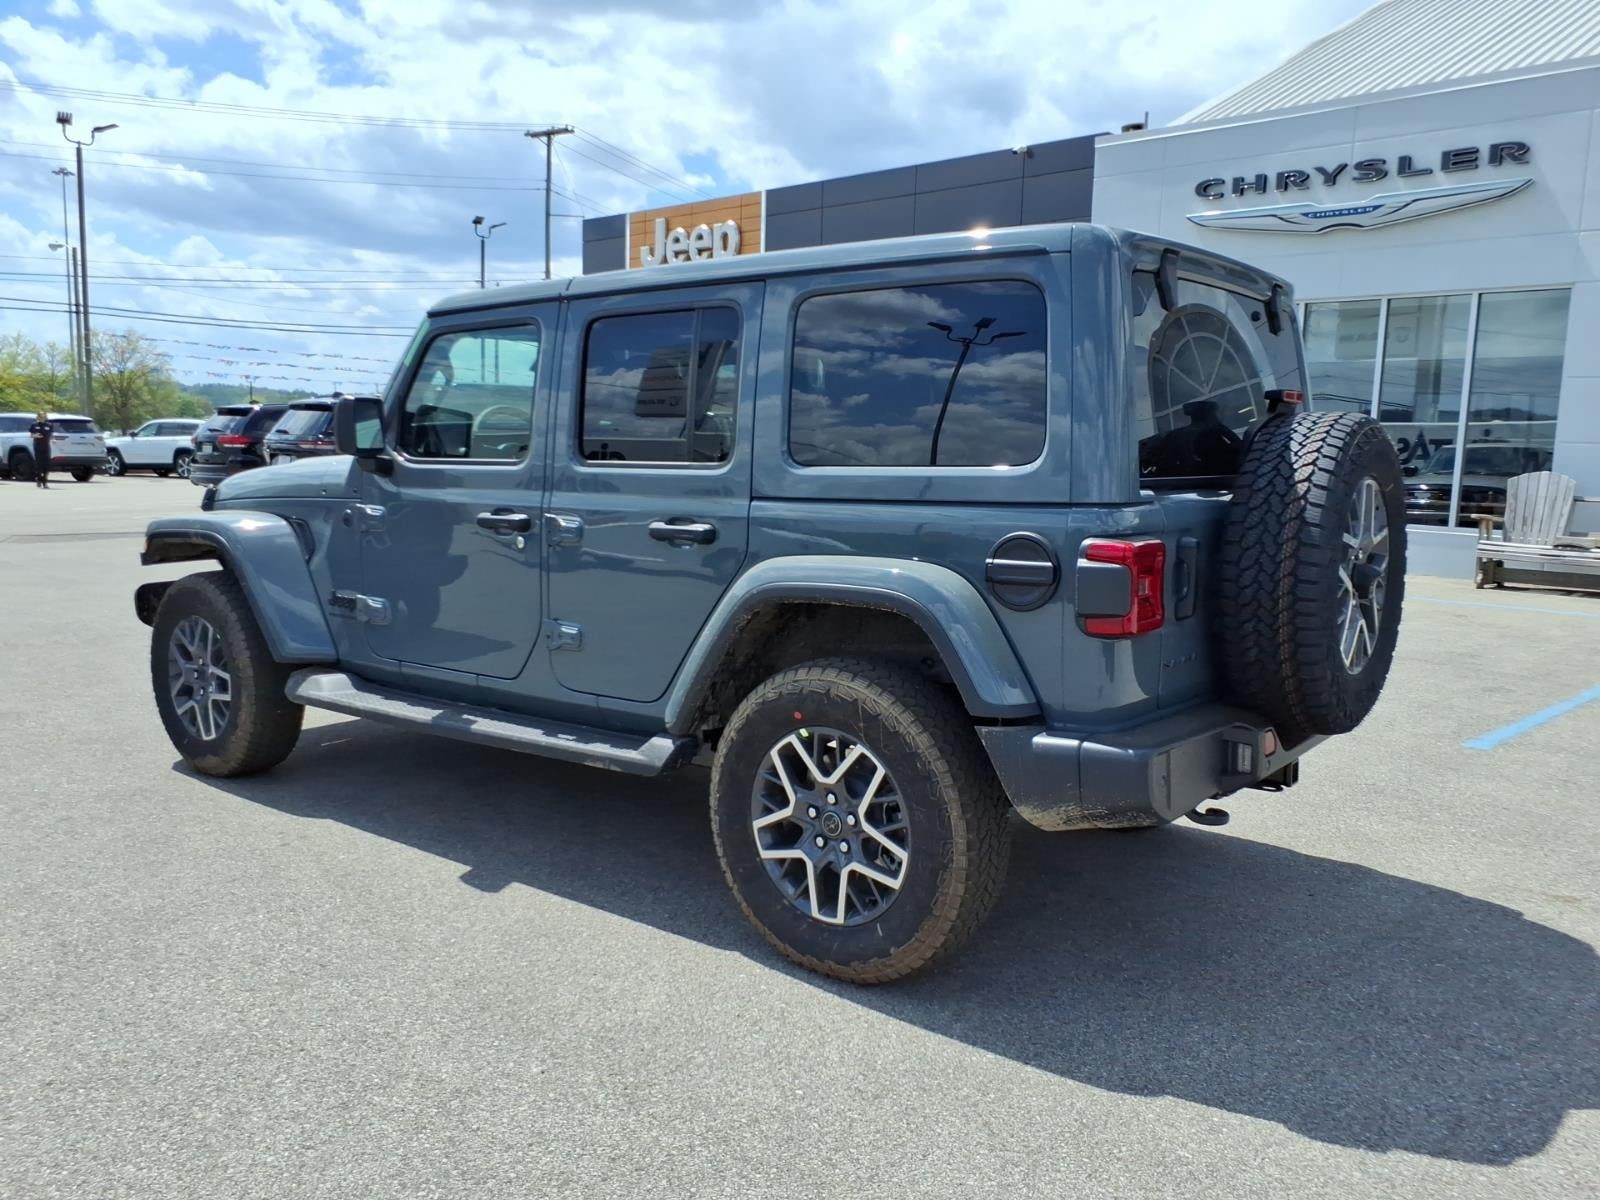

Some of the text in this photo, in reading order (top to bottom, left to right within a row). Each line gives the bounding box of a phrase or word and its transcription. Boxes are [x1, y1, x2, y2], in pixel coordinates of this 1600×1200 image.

[1194, 140, 1532, 200] CHRYSLER
[1307, 206, 1374, 218] CHRYSLER
[639, 217, 741, 267] Jeep
